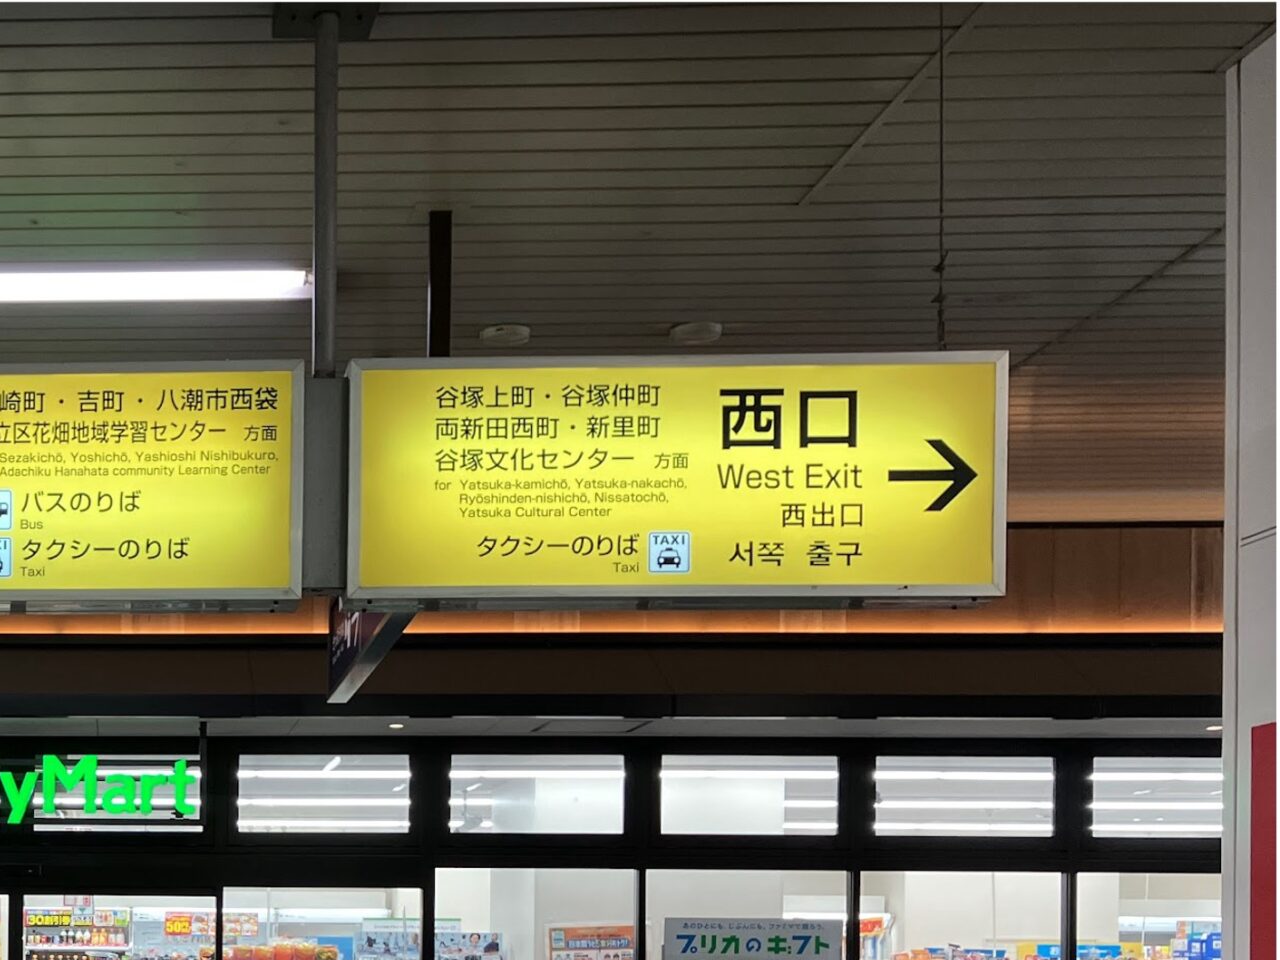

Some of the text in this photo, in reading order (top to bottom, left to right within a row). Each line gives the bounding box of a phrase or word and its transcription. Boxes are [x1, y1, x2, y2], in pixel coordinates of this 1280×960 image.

[436, 384, 661, 408] 谷塚上町・谷塚仲町
[435, 416, 660, 440] 両新田西町・新里町
[720, 388, 857, 449] 西口
[244, 425, 278, 441] 方面
[136, 451, 196, 462] Yashioshi
[200, 450, 280, 464] Nishibukuro,
[436, 448, 688, 472] 谷塚文化センター 方面
[0, 463, 272, 477] Adachiku Hanahata community Learning Center
[717, 463, 862, 489] West Exit
[434, 480, 451, 490] for
[22, 490, 141, 512] バスのりば
[459, 507, 612, 518] Yatsuka Cultural Center
[781, 502, 862, 527] 西出口
[20, 519, 43, 529] Bus
[22, 538, 189, 560] タクシーのりば
[477, 534, 639, 557] タクシーのりば
[652, 535, 686, 544] TAXI
[729, 541, 862, 566] 서쪽 출구
[20, 567, 45, 577] Taxi
[613, 562, 639, 572] Taxi
